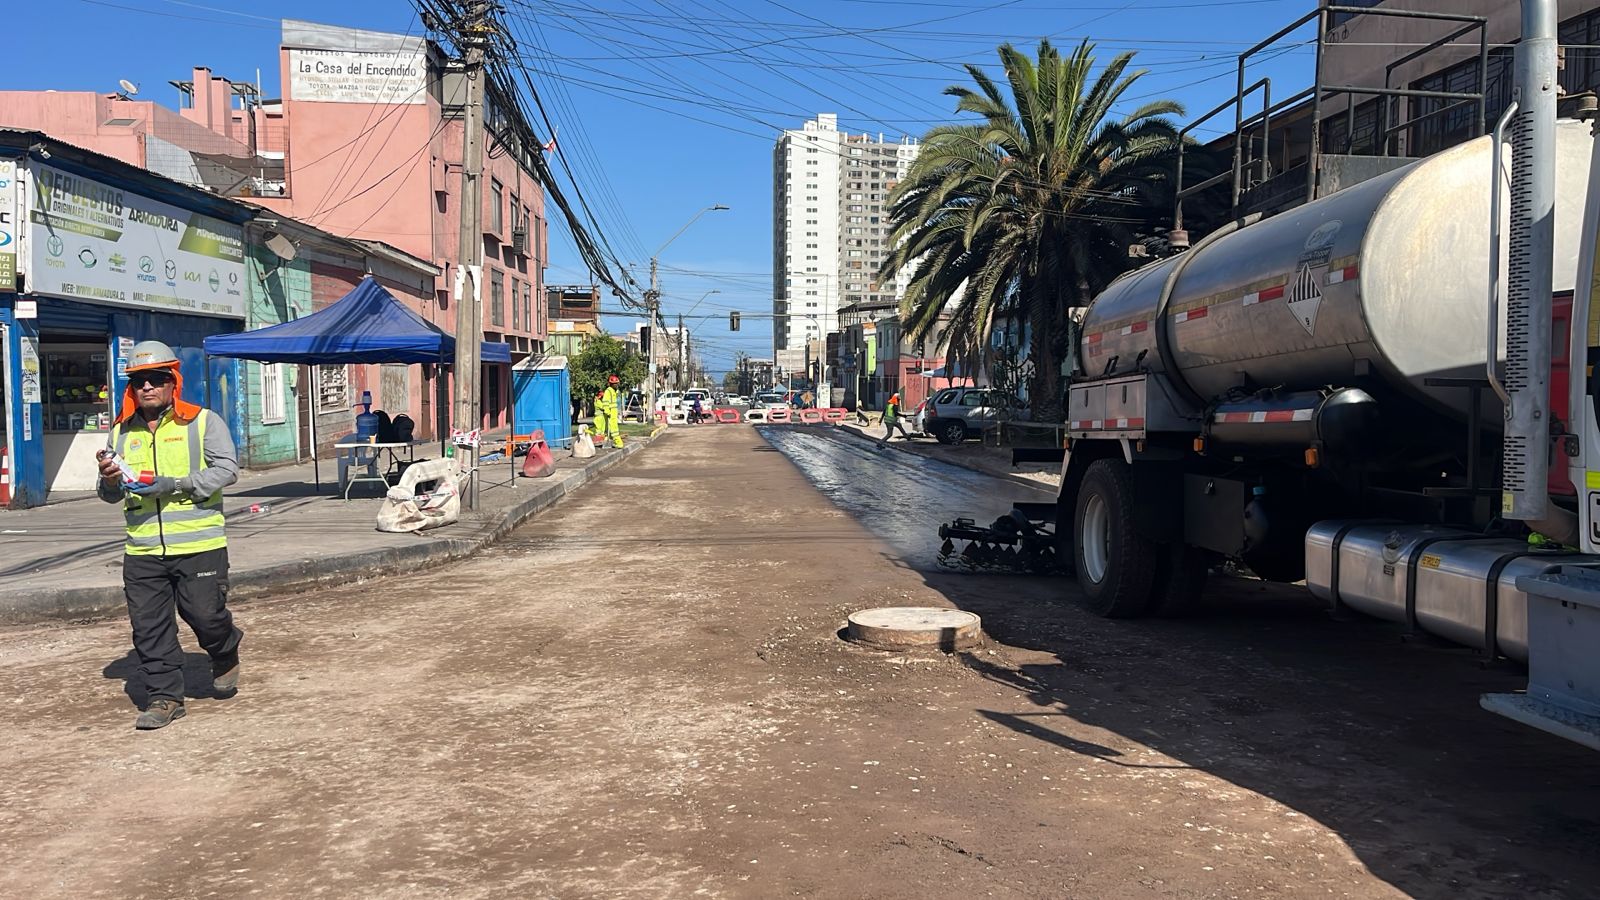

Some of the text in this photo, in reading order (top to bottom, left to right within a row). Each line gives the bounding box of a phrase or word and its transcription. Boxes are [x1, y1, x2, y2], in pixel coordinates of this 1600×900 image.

[299, 60, 417, 77] La Casa del Encendido
[37, 168, 124, 216] REPUESTOS
[53, 200, 84, 218] ORIGINALES
[89, 210, 124, 229] ALTERNATIVOS
[128, 207, 179, 233] ARMADURA
[46, 258, 65, 268] TOYOTA
